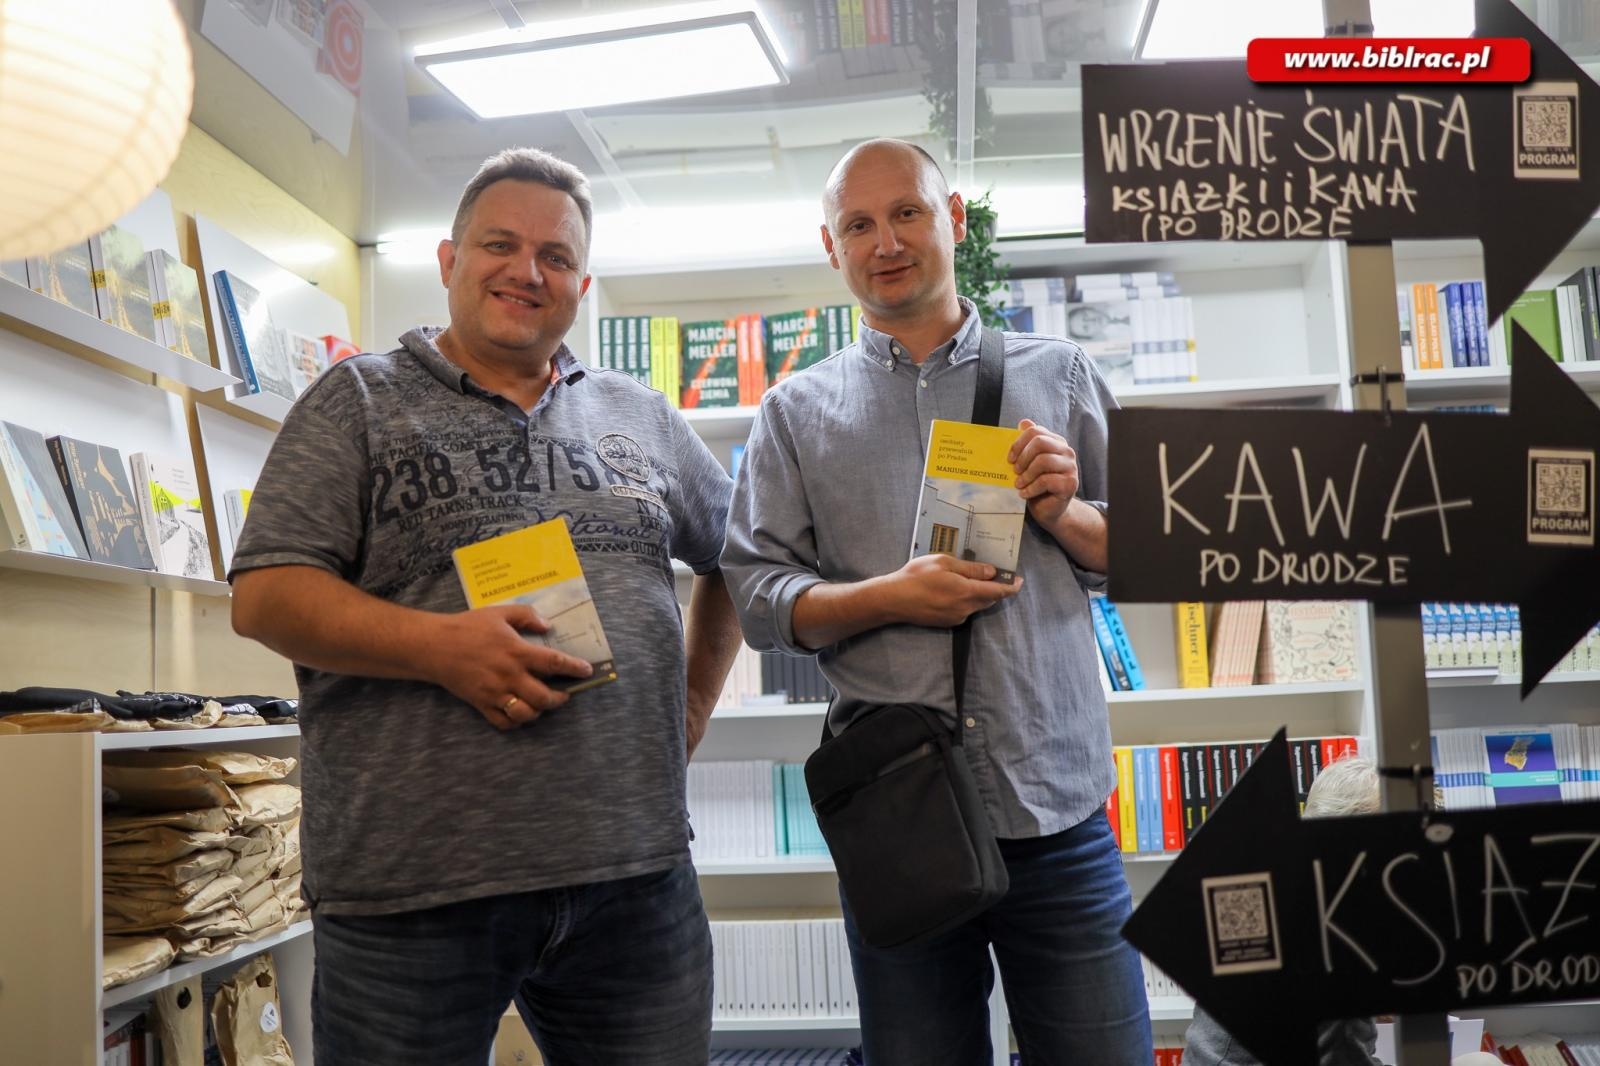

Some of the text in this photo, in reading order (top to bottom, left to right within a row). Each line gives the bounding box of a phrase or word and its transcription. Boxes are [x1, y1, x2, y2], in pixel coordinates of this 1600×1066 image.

[1098, 88, 1475, 173] WRZENIE ŚWIATA
[1519, 153, 1576, 165] PROGRAM
[1309, 167, 1418, 214] KAWA
[1220, 205, 1352, 241] DRODZE
[688, 327, 736, 342] MARCIN
[772, 317, 817, 335] MARCIN
[773, 333, 818, 352] MELLER
[689, 343, 737, 360] MELLER
[1159, 421, 1472, 554] KAWA
[398, 494, 524, 532] RED TARNS TRACK
[1532, 517, 1589, 531] PROGRAM
[1200, 548, 1410, 587] PO DRODZE
[1188, 604, 1200, 656] ischner
[1456, 964, 1498, 998] PO
